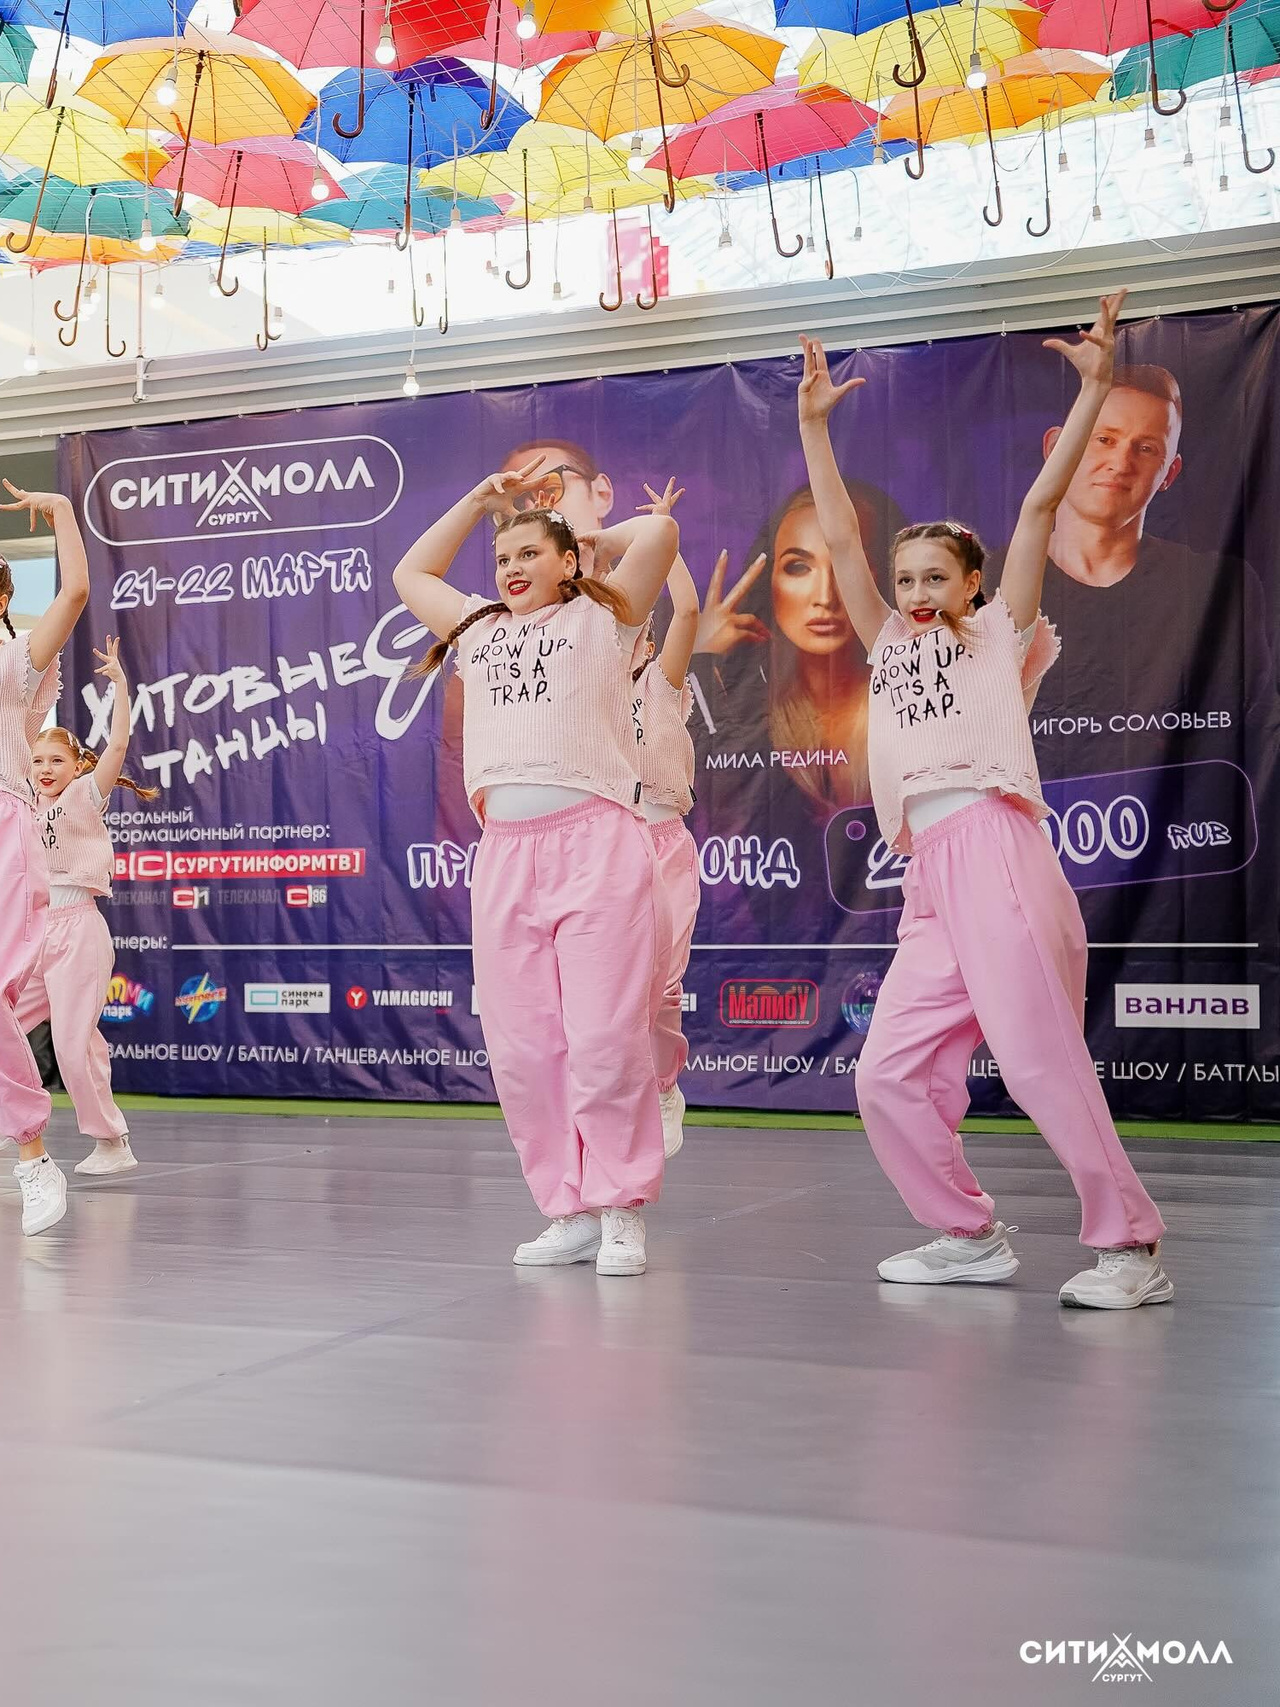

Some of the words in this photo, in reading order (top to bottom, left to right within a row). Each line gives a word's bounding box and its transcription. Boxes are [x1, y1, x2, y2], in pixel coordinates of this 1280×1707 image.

[207, 510, 259, 527] СУРГУТ
[109, 562, 234, 610] 21-22
[241, 547, 372, 599] МАРТА
[491, 623, 550, 644] DN'T
[471, 640, 525, 665] GROW
[539, 638, 573, 657] UP.
[882, 627, 945, 666] DON'T
[487, 662, 521, 683] IT'S
[532, 658, 546, 679] A
[872, 653, 921, 695] GROW
[934, 643, 974, 669] UP.
[490, 680, 552, 706] TRAP.
[890, 678, 924, 708] IT'S
[933, 670, 950, 693] A
[895, 693, 962, 729] TRAP.
[1033, 716, 1103, 736] ИГОРЬ
[1109, 711, 1232, 733] СОЛОВЬЕВ
[141, 701, 328, 788] ТАНЦЫ
[705, 752, 764, 770] МИЛА
[770, 749, 849, 769] РЕДИНА
[45, 821, 55, 835] A
[102, 805, 195, 829] неральный
[109, 823, 244, 846] ормационный
[248, 824, 331, 843] партнер:
[1168, 821, 1232, 850] RUB
[698, 834, 801, 889] ОНД
[218, 888, 280, 905] ТЕЛЕКАНАЛ
[111, 935, 168, 952] тнеры:
[281, 989, 324, 999] синема
[281, 998, 309, 1009] парк
[372, 990, 453, 1007] YAMAGUCHI
[103, 1004, 132, 1020] парк
[1125, 996, 1250, 1016] ванлав
[107, 1043, 178, 1060] ВАЛЬНОЕ
[181, 1044, 223, 1061] ШОУ
[238, 1046, 298, 1063] БАТТЛЫ
[315, 1046, 451, 1066] ТАНЦЕВАЛЬНОЕ
[455, 1048, 489, 1067] ШО
[763, 1055, 814, 1074] ШОУ
[1112, 1061, 1169, 1081] ШОУ
[1194, 1062, 1280, 1083] БАТТЛЫ
